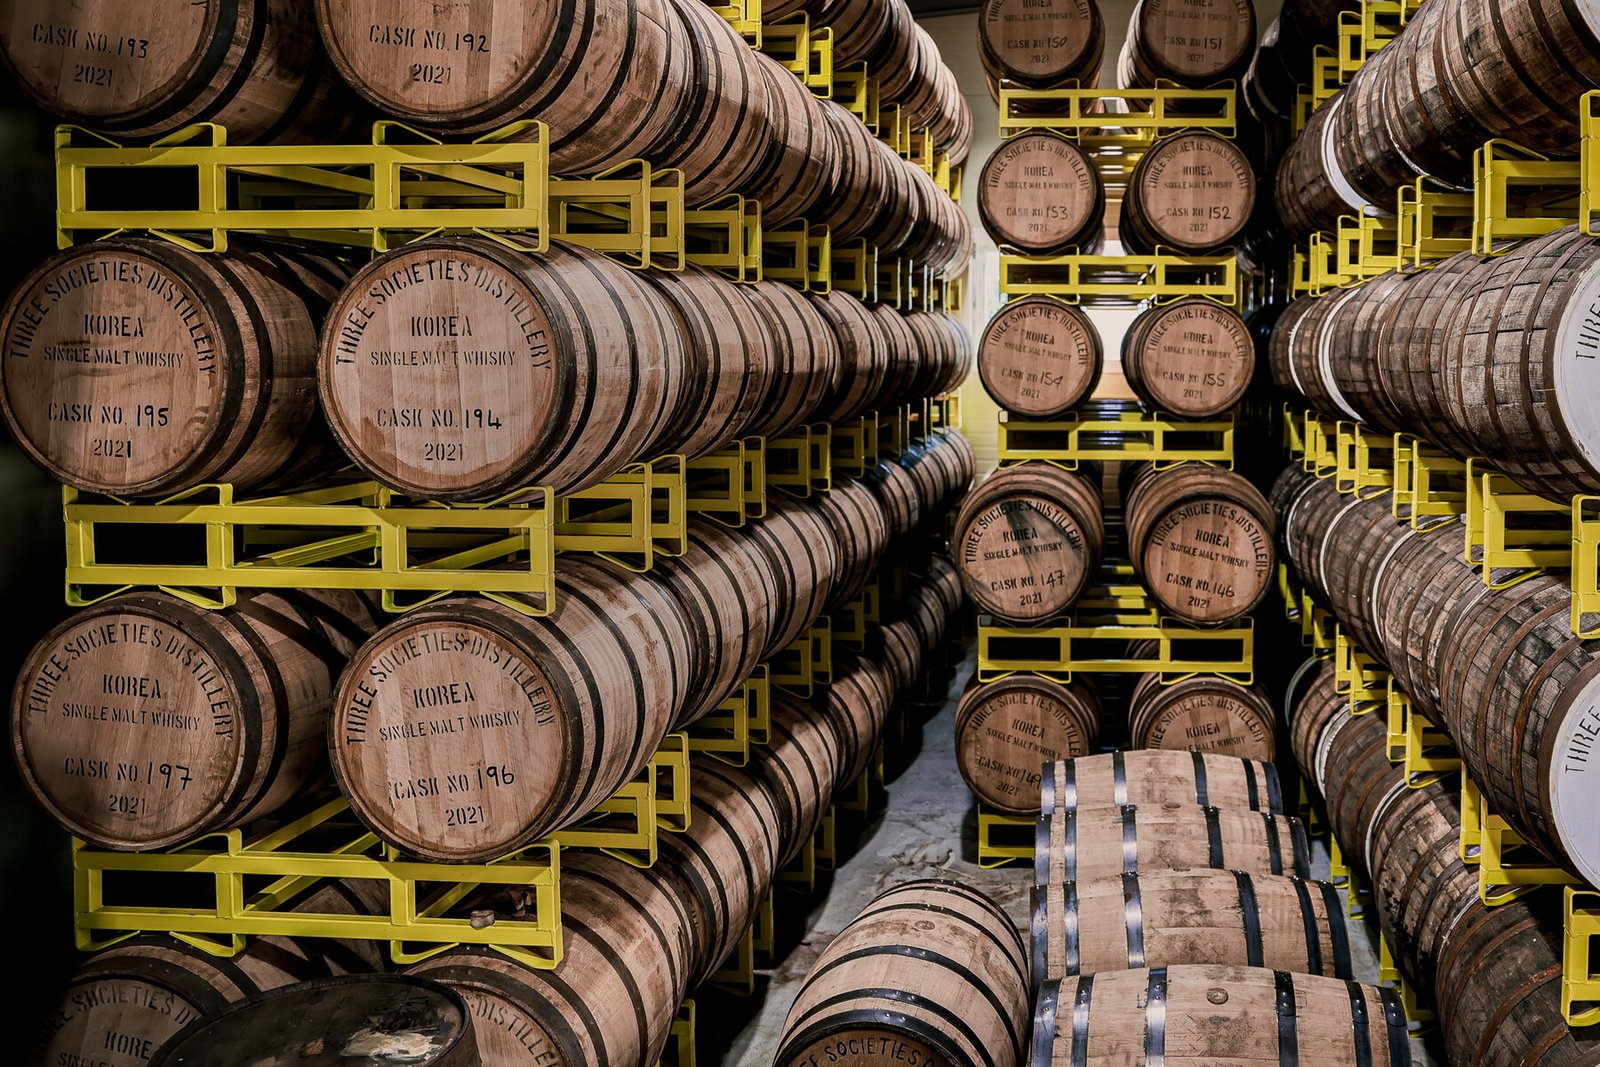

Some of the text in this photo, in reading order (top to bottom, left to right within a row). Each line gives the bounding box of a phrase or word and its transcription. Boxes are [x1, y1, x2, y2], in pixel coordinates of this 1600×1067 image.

[32, 23, 149, 58] CASK NO. 193
[369, 24, 490, 53] CASK NO. 192
[1204, 37, 1222, 50] 151
[1030, 54, 1050, 63] 2021
[73, 64, 113, 87] 2021
[412, 63, 451, 85] 2021
[1024, 166, 1053, 176] KOREA
[1183, 165, 1213, 176] KOREA
[1006, 207, 1028, 217] CASK
[1046, 206, 1068, 220] 153
[1166, 207, 1189, 217] CASK
[1208, 206, 1231, 220] 152
[1028, 223, 1048, 232] 2021
[1189, 223, 1208, 232] 2021
[10, 261, 216, 374] THREE SOCIETIES DISTILLERY
[336, 259, 551, 369] THREE SOCIETIES DISTILLERY
[84, 314, 144, 337] KOREA
[411, 315, 472, 336] KOREA
[1576, 295, 1600, 360] THRE
[1026, 330, 1055, 345] KOREA
[1184, 332, 1213, 344] KOREA
[43, 346, 184, 368] SINGLE MALT WHISKY
[370, 351, 516, 367] SINGLE MALT WHISKY
[1001, 368, 1024, 380] CASK
[1040, 371, 1063, 389] 154
[1163, 371, 1185, 382] CASK
[1203, 372, 1226, 387] 155
[1021, 387, 1040, 398] 2021
[1184, 389, 1203, 398] 2021
[48, 402, 169, 427] CASK NO. 195
[377, 408, 502, 430] CASK NO. 194
[93, 439, 132, 458] 2021
[424, 443, 463, 461] 2021
[1003, 527, 1038, 543] KOREA
[1152, 502, 1267, 577] THREE SOCIETIES DISTILLERY
[1196, 529, 1230, 548] KOREA
[965, 528, 983, 564] THREE
[1012, 546, 1032, 557] MALT
[1199, 549, 1219, 561] MALT
[991, 578, 1018, 592] CASK
[1041, 570, 1065, 588] 147
[1167, 573, 1192, 588] CASK
[1213, 582, 1235, 598] 146
[1020, 592, 1042, 606] 2021
[1188, 596, 1210, 608] 2021
[29, 623, 233, 740] THREE SOCIETIES DISTILLERY
[103, 674, 161, 699] KOREA
[347, 631, 556, 745] THREE SOCIETIES DISTILLERY
[413, 682, 475, 708] KOREA
[62, 702, 200, 731] SINGLE MALT WHISKY
[379, 710, 520, 742] SINGLE MALT WHISKY
[970, 694, 1081, 758] THREE SOCIETIES DISTILLE
[1150, 696, 1266, 750] HREE SOCIETIES DISTILLERY
[1012, 719, 1045, 739] KOREA
[1186, 722, 1221, 740] KOREA
[1014, 736, 1033, 751] MALT
[64, 757, 193, 790] CASK NO. 197
[394, 765, 514, 800] CASK NO. 196
[978, 757, 1004, 773] CASK
[1020, 769, 1042, 790] 149
[996, 781, 1019, 796] 2021
[108, 794, 146, 814] 2021
[445, 805, 484, 826] 2021
[72, 985, 175, 1015] SOCIETIES
[477, 1000, 560, 1067] DISTILLE
[104, 1031, 153, 1060] KORE
[824, 1037, 921, 1066] SOCIETIES
